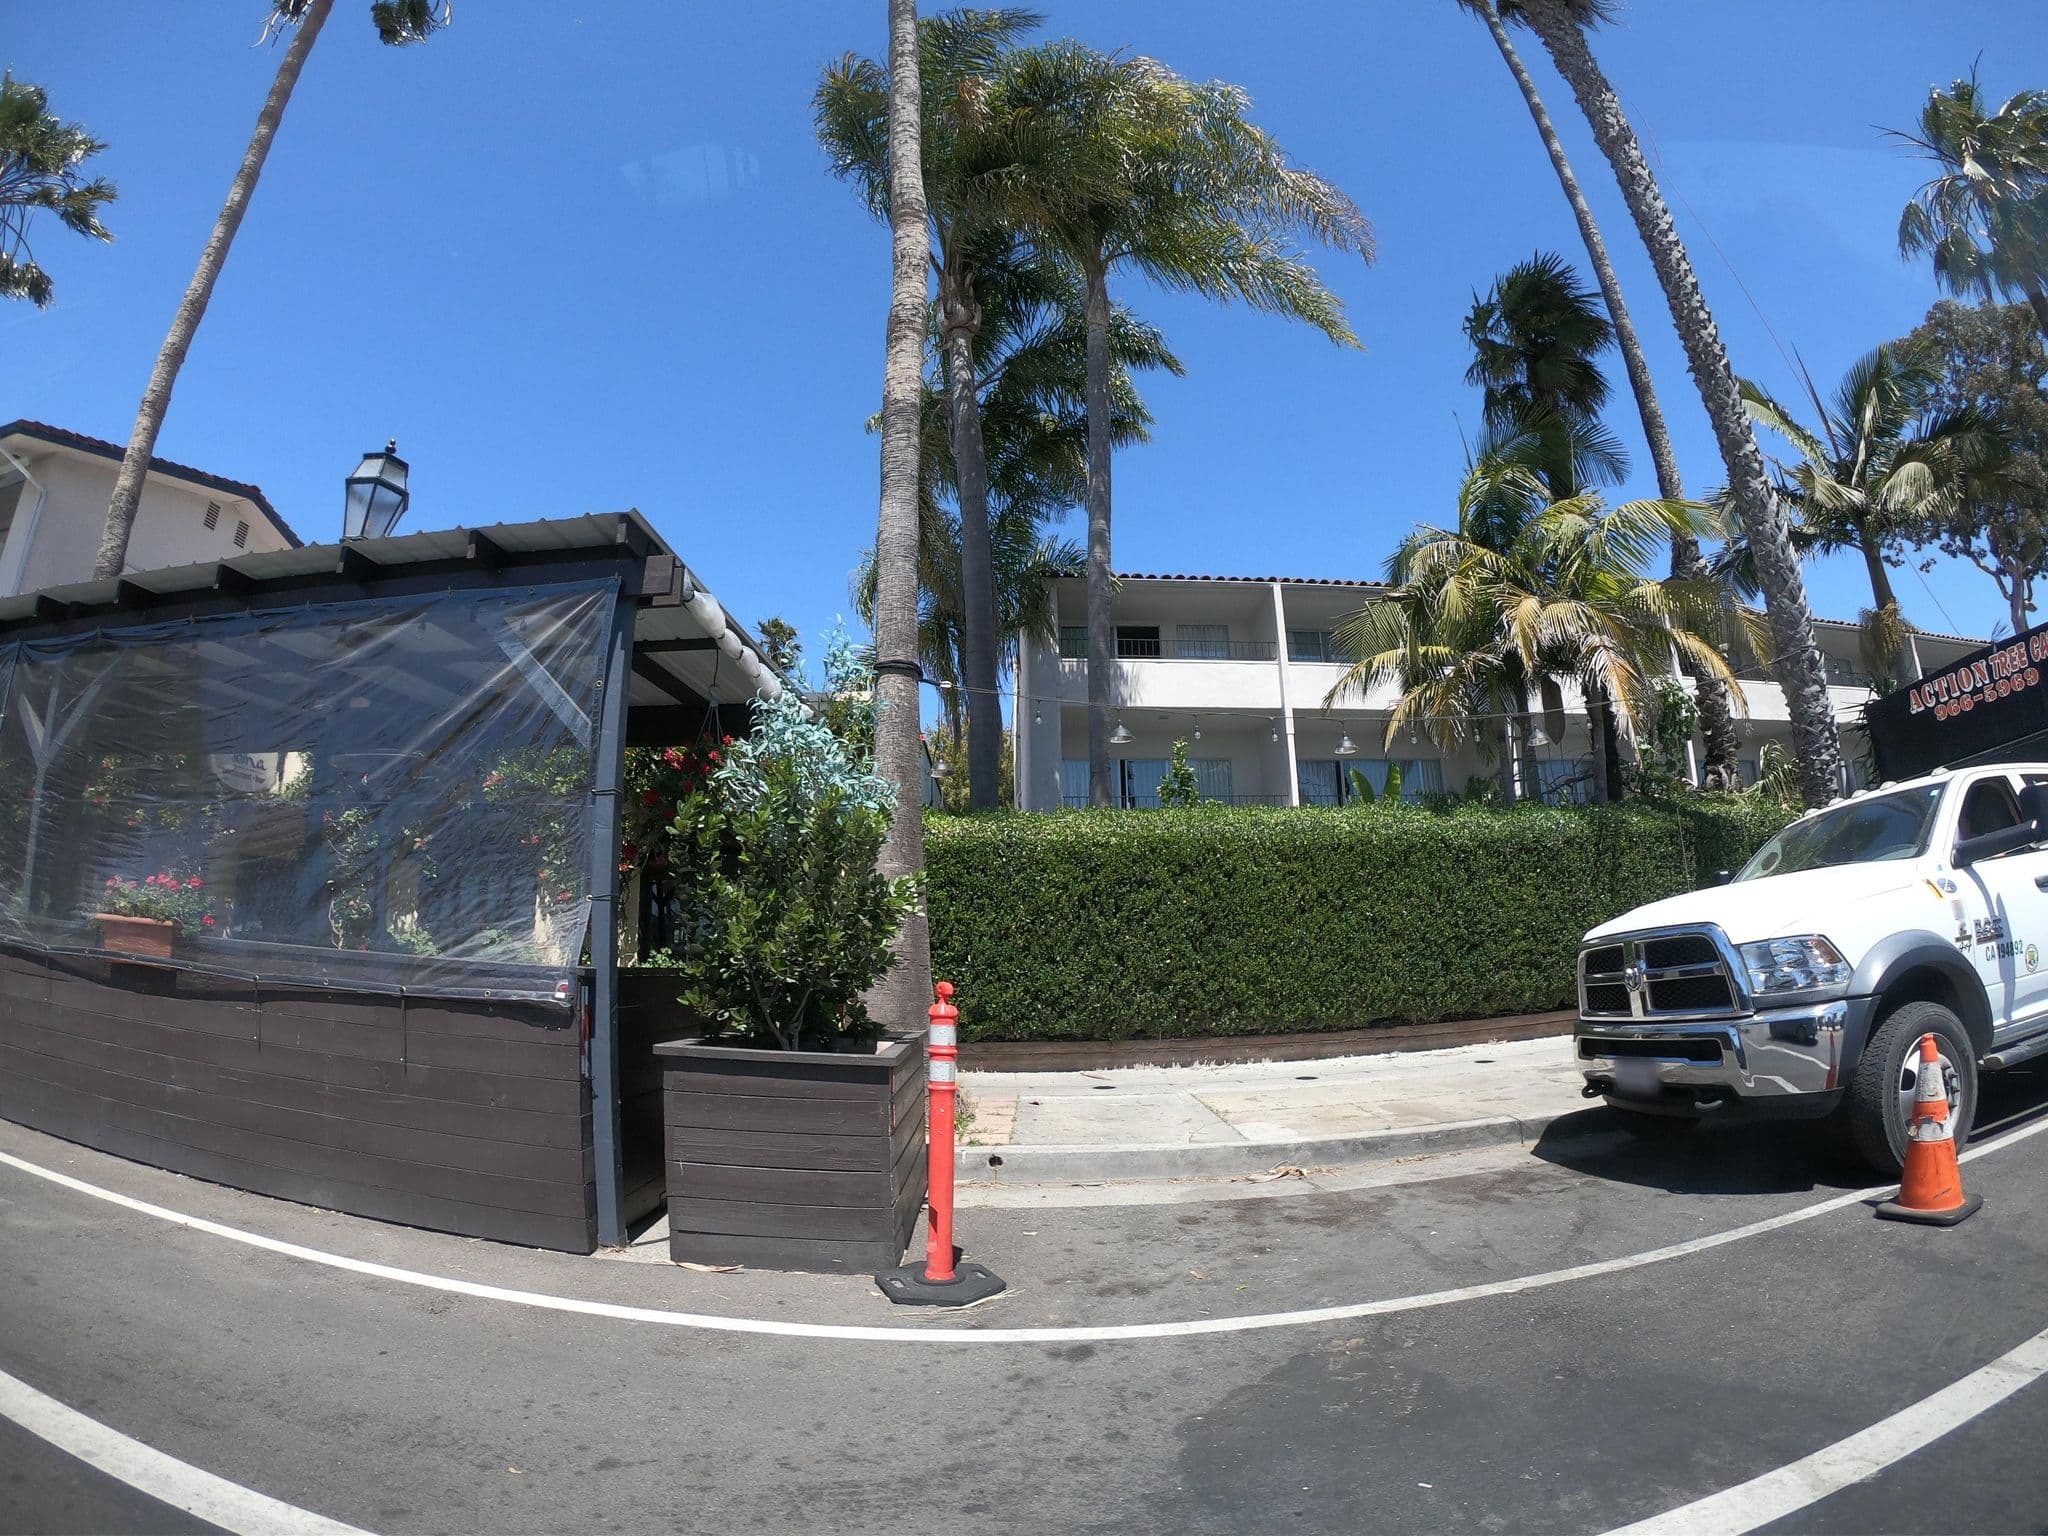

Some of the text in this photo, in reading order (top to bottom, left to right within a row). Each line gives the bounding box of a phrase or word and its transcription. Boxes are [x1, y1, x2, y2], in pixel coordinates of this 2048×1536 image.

[1909, 659, 1989, 714] ACTION
[1988, 642, 2028, 680] TREE
[1934, 667, 2039, 721] 966-5969
[1985, 945, 1996, 961] CA
